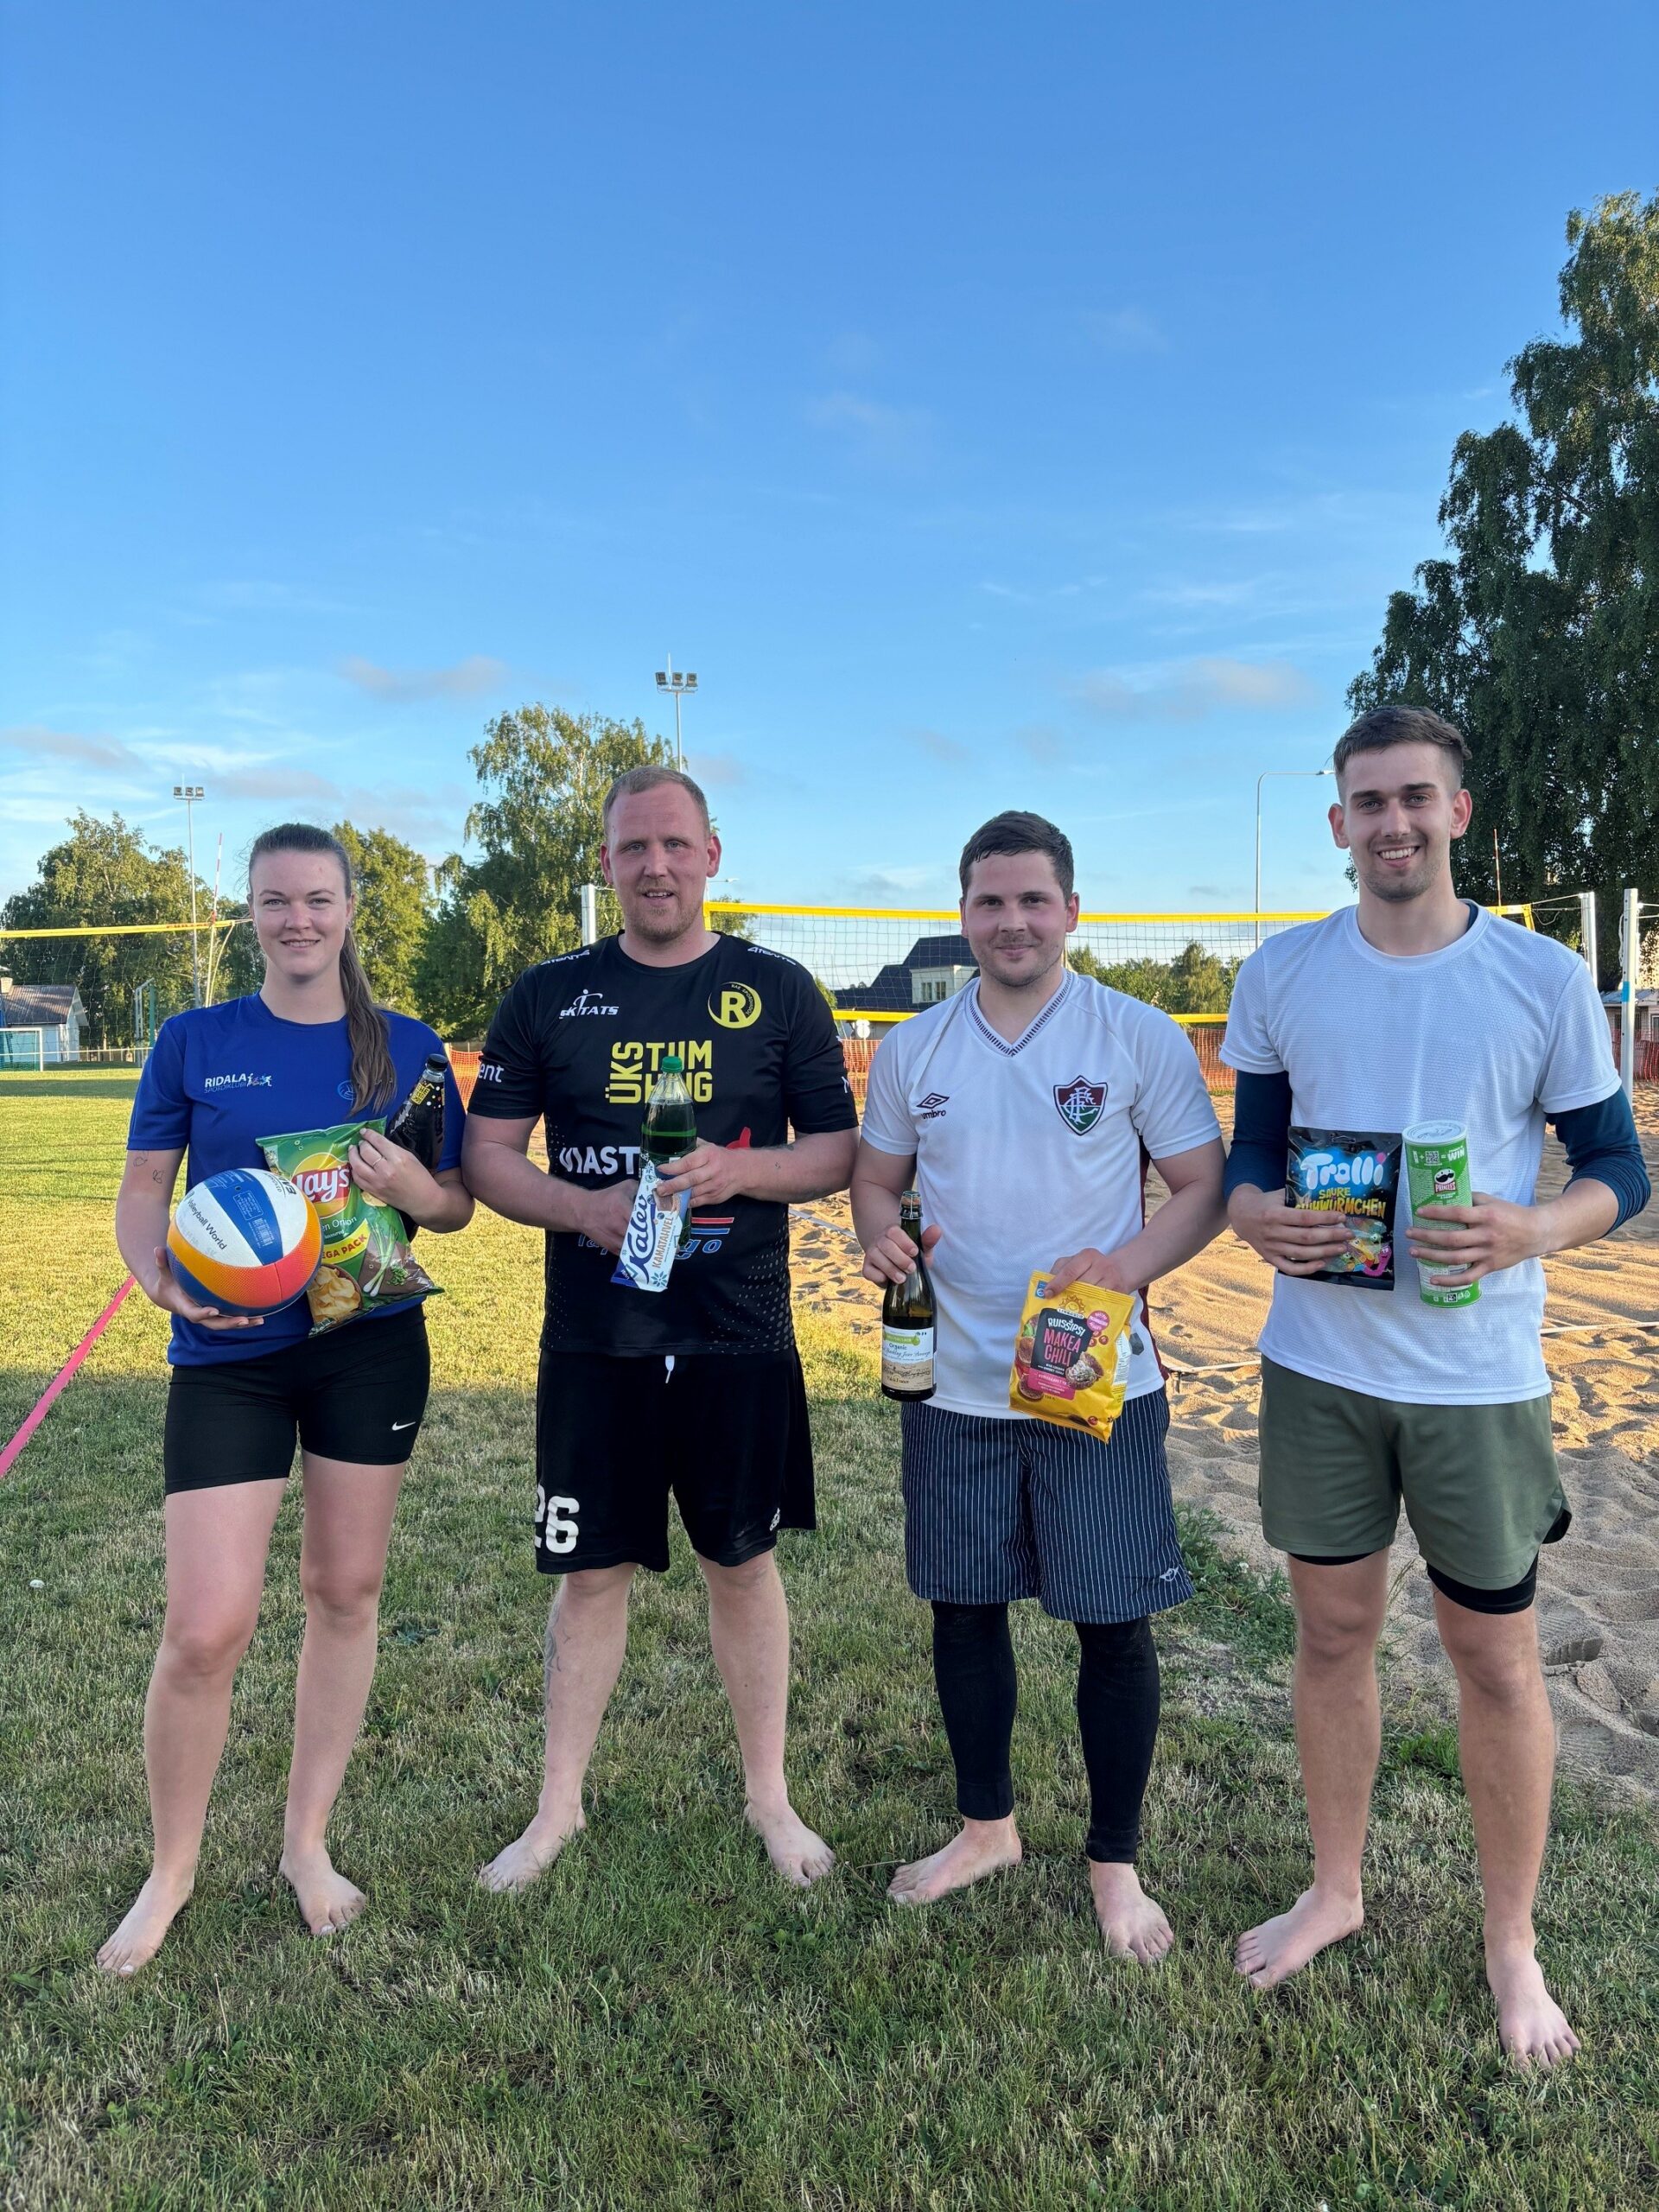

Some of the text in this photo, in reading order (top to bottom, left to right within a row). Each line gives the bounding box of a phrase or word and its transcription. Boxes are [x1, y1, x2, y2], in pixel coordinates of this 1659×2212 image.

[204, 1073, 247, 1088] RIDALA
[605, 1041, 644, 1104] ÜKS
[921, 1109, 947, 1120] umbro
[1447, 1147, 1465, 1162] WIN
[1300, 1152, 1387, 1191] Trolli
[332, 1217, 358, 1228] Onion
[206, 1223, 228, 1250] World
[322, 1234, 368, 1259] EGA PACK
[626, 1193, 657, 1285] Kalev
[652, 1217, 674, 1269] KAMATAHVEL
[1047, 1317, 1086, 1338] RUISSIPSI
[1043, 1327, 1082, 1354] MAKEA
[1044, 1344, 1072, 1367] CHILI
